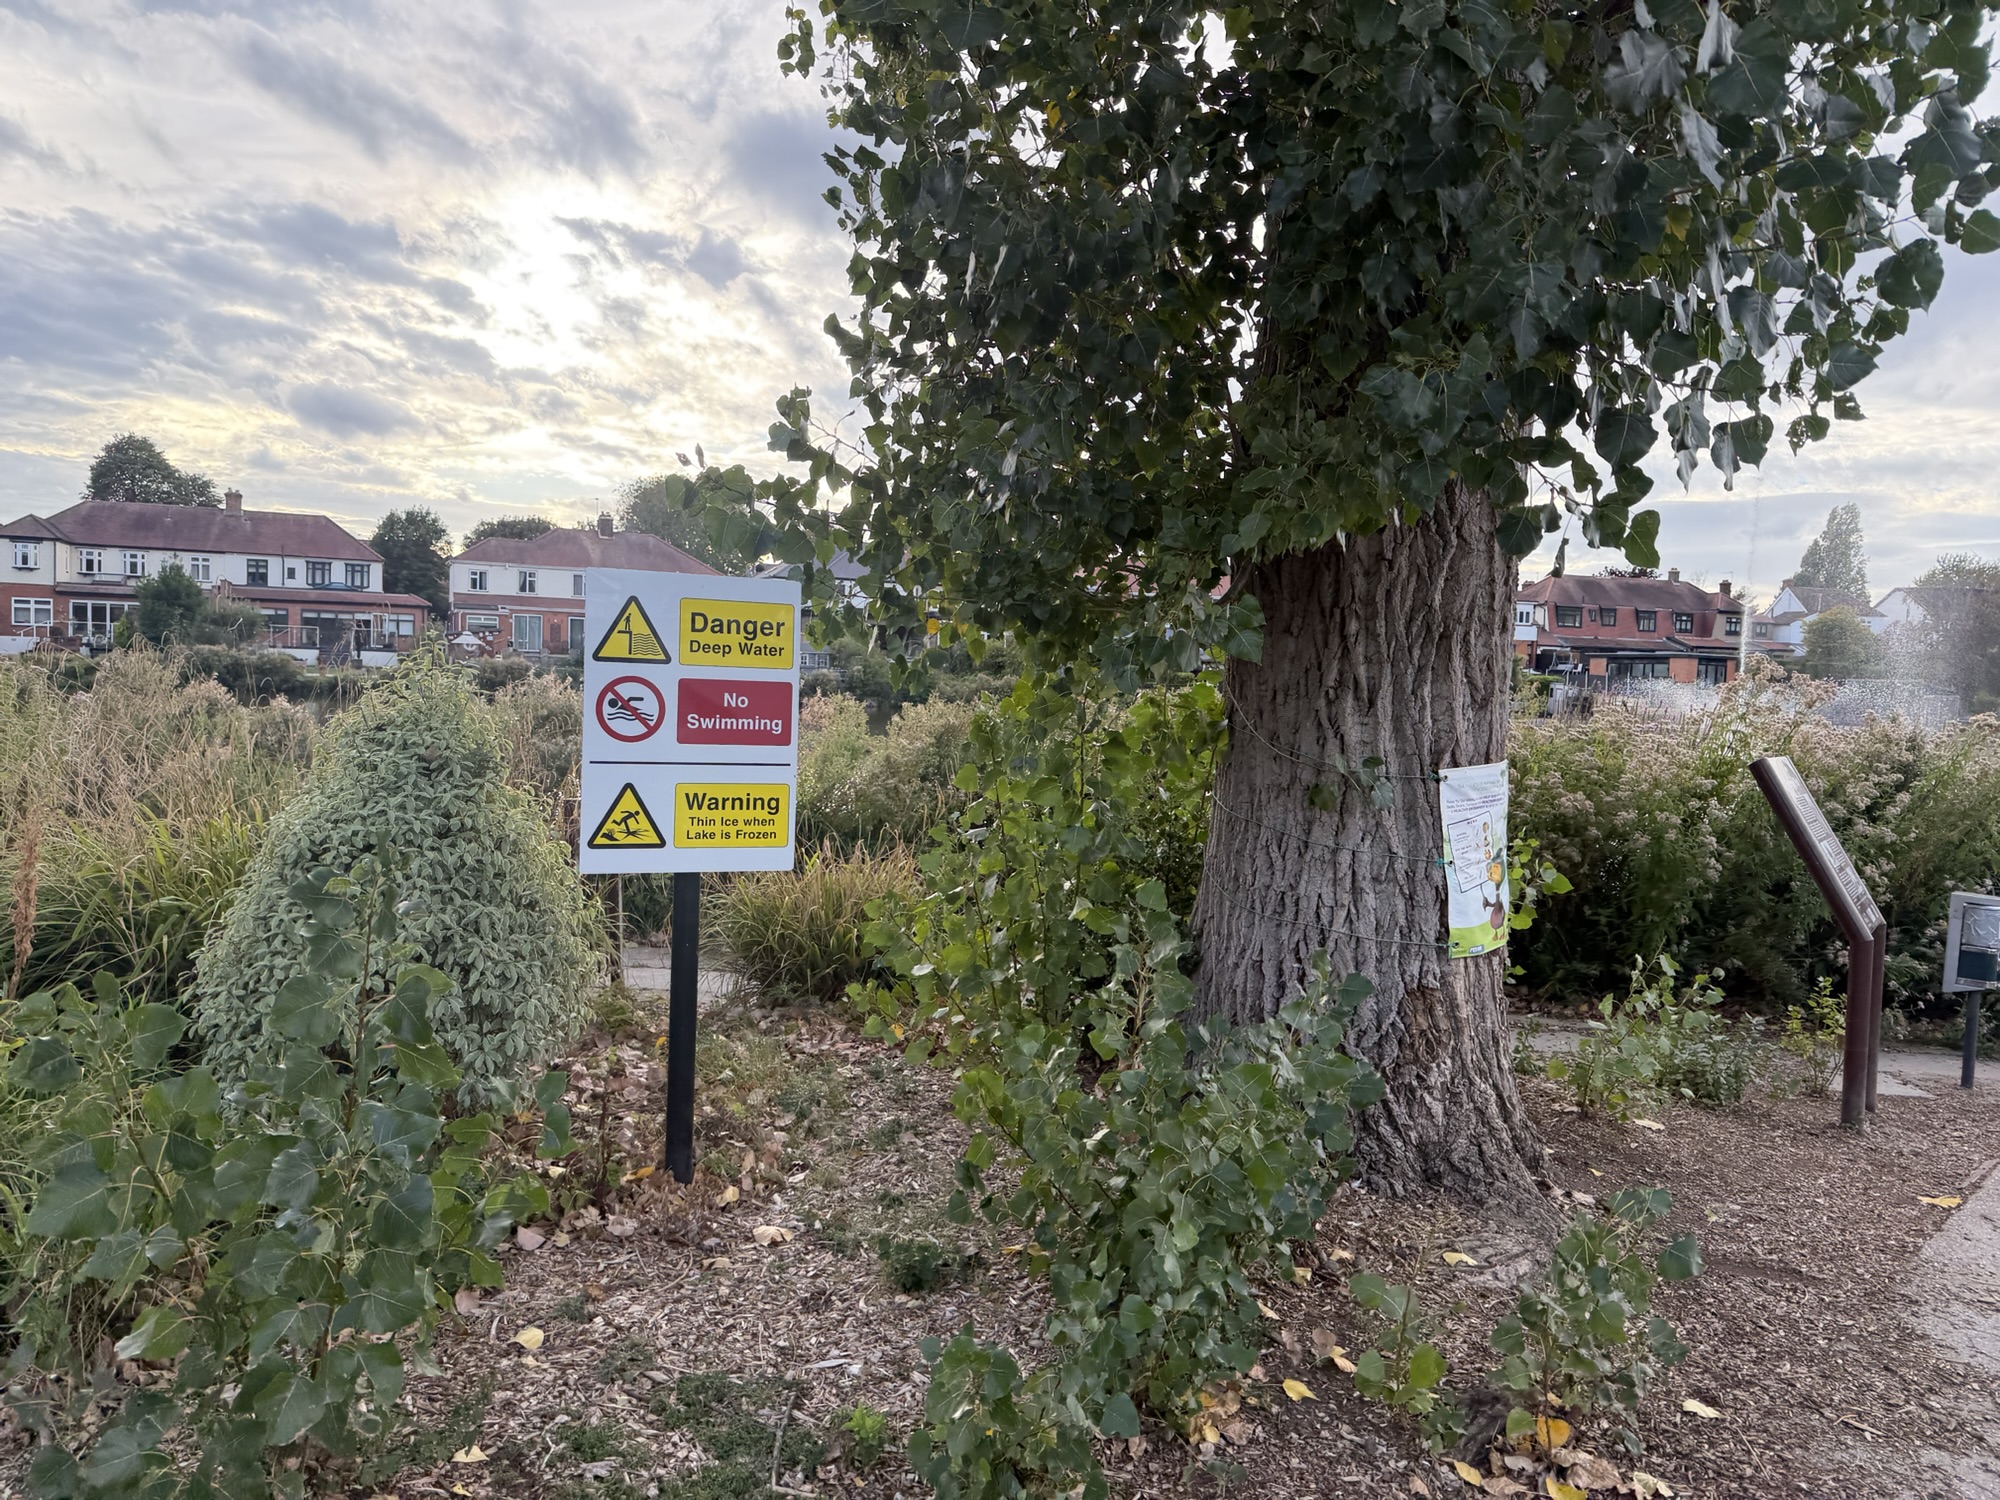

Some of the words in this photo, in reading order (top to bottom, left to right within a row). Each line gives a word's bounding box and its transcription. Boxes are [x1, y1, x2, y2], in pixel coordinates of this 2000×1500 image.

[690, 611, 786, 642] Danger
[689, 639, 732, 658] Deep
[738, 641, 785, 657] Water
[723, 692, 749, 708] No
[686, 713, 783, 735] Swimming
[684, 792, 780, 816] Warning
[688, 816, 716, 827] Thin
[720, 816, 739, 827] Ice
[743, 816, 775, 827] when
[686, 829, 716, 840] Lake
[720, 829, 731, 840] is
[735, 829, 777, 840] Frozen
